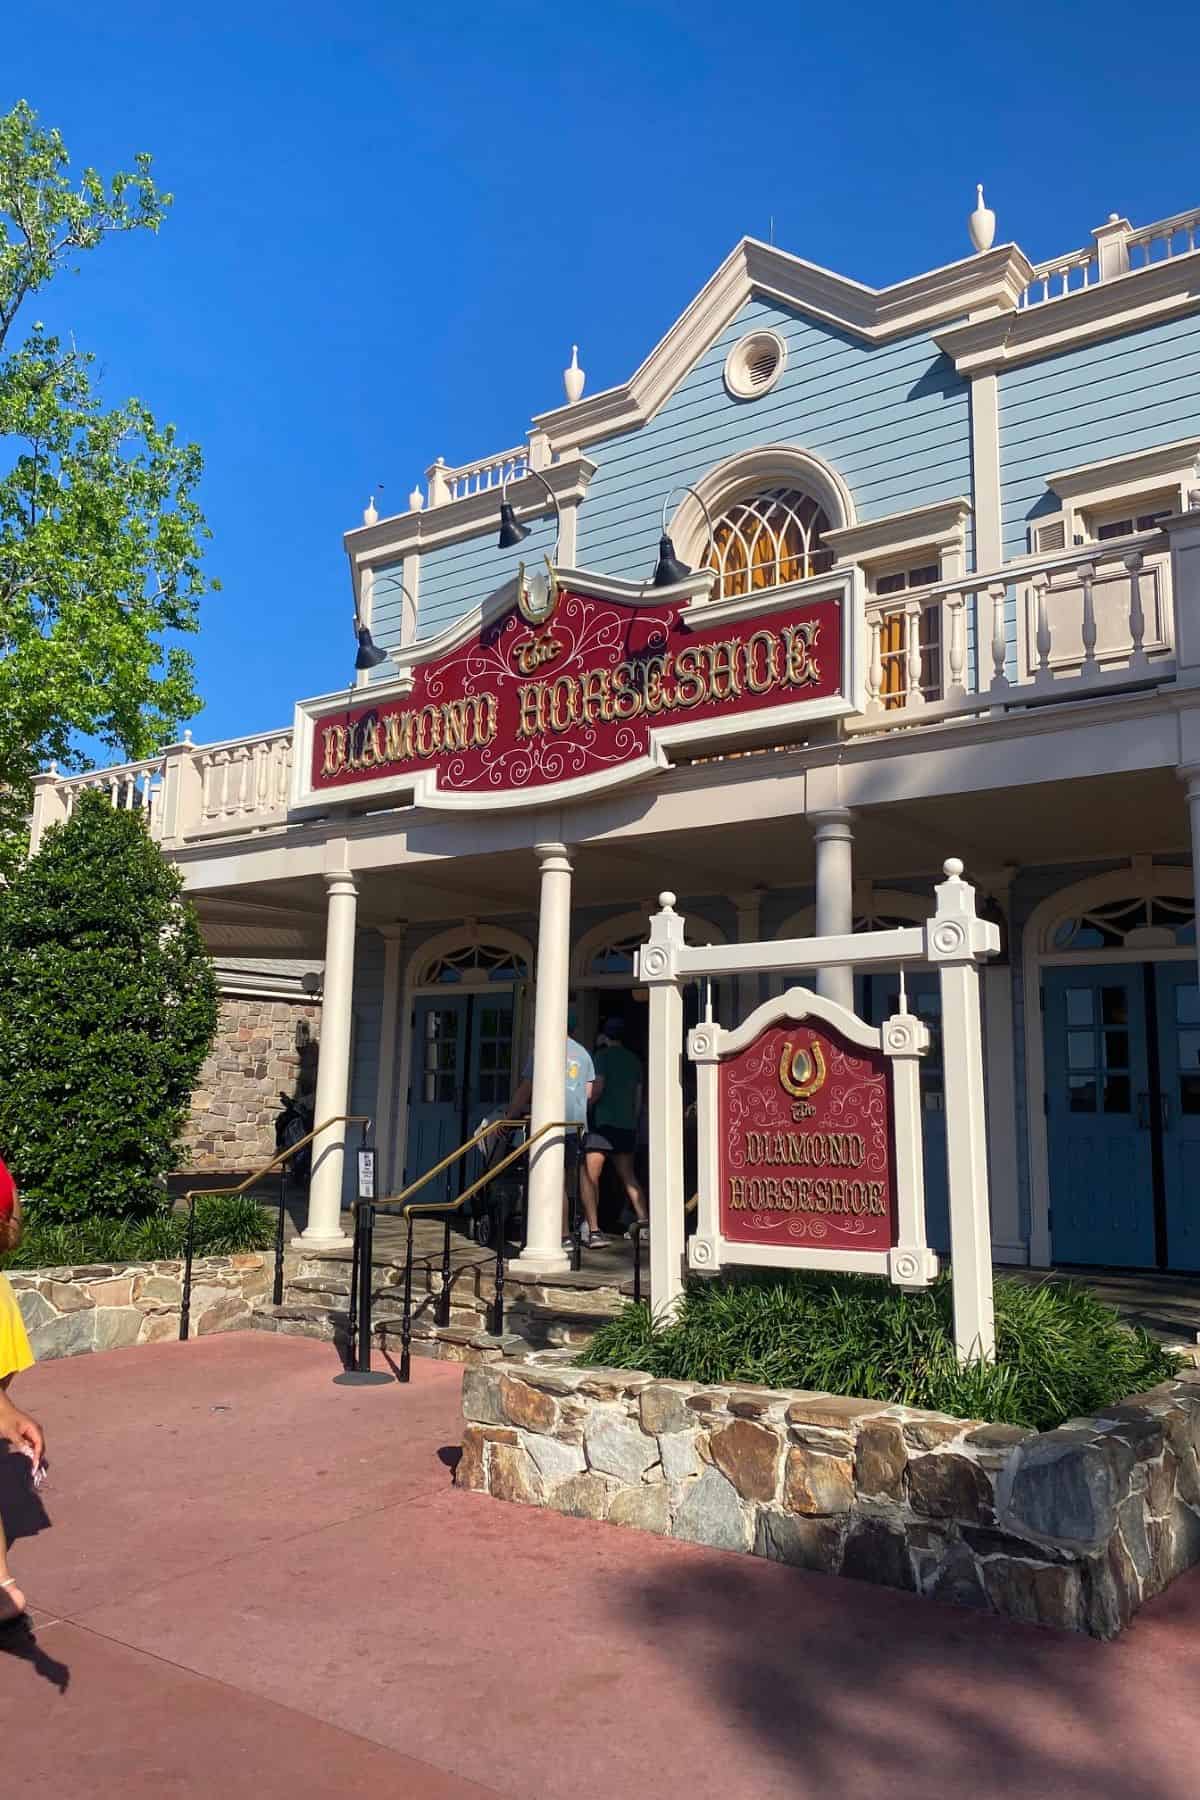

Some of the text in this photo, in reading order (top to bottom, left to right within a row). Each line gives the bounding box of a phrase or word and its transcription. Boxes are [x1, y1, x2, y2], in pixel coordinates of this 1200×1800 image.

[513, 630, 561, 675] The
[320, 620, 821, 776] DIAMOND HORSESHOE
[791, 1102, 816, 1122] The
[745, 1132, 865, 1168] DIAMOND
[728, 1176, 887, 1217] HORSESHOE
